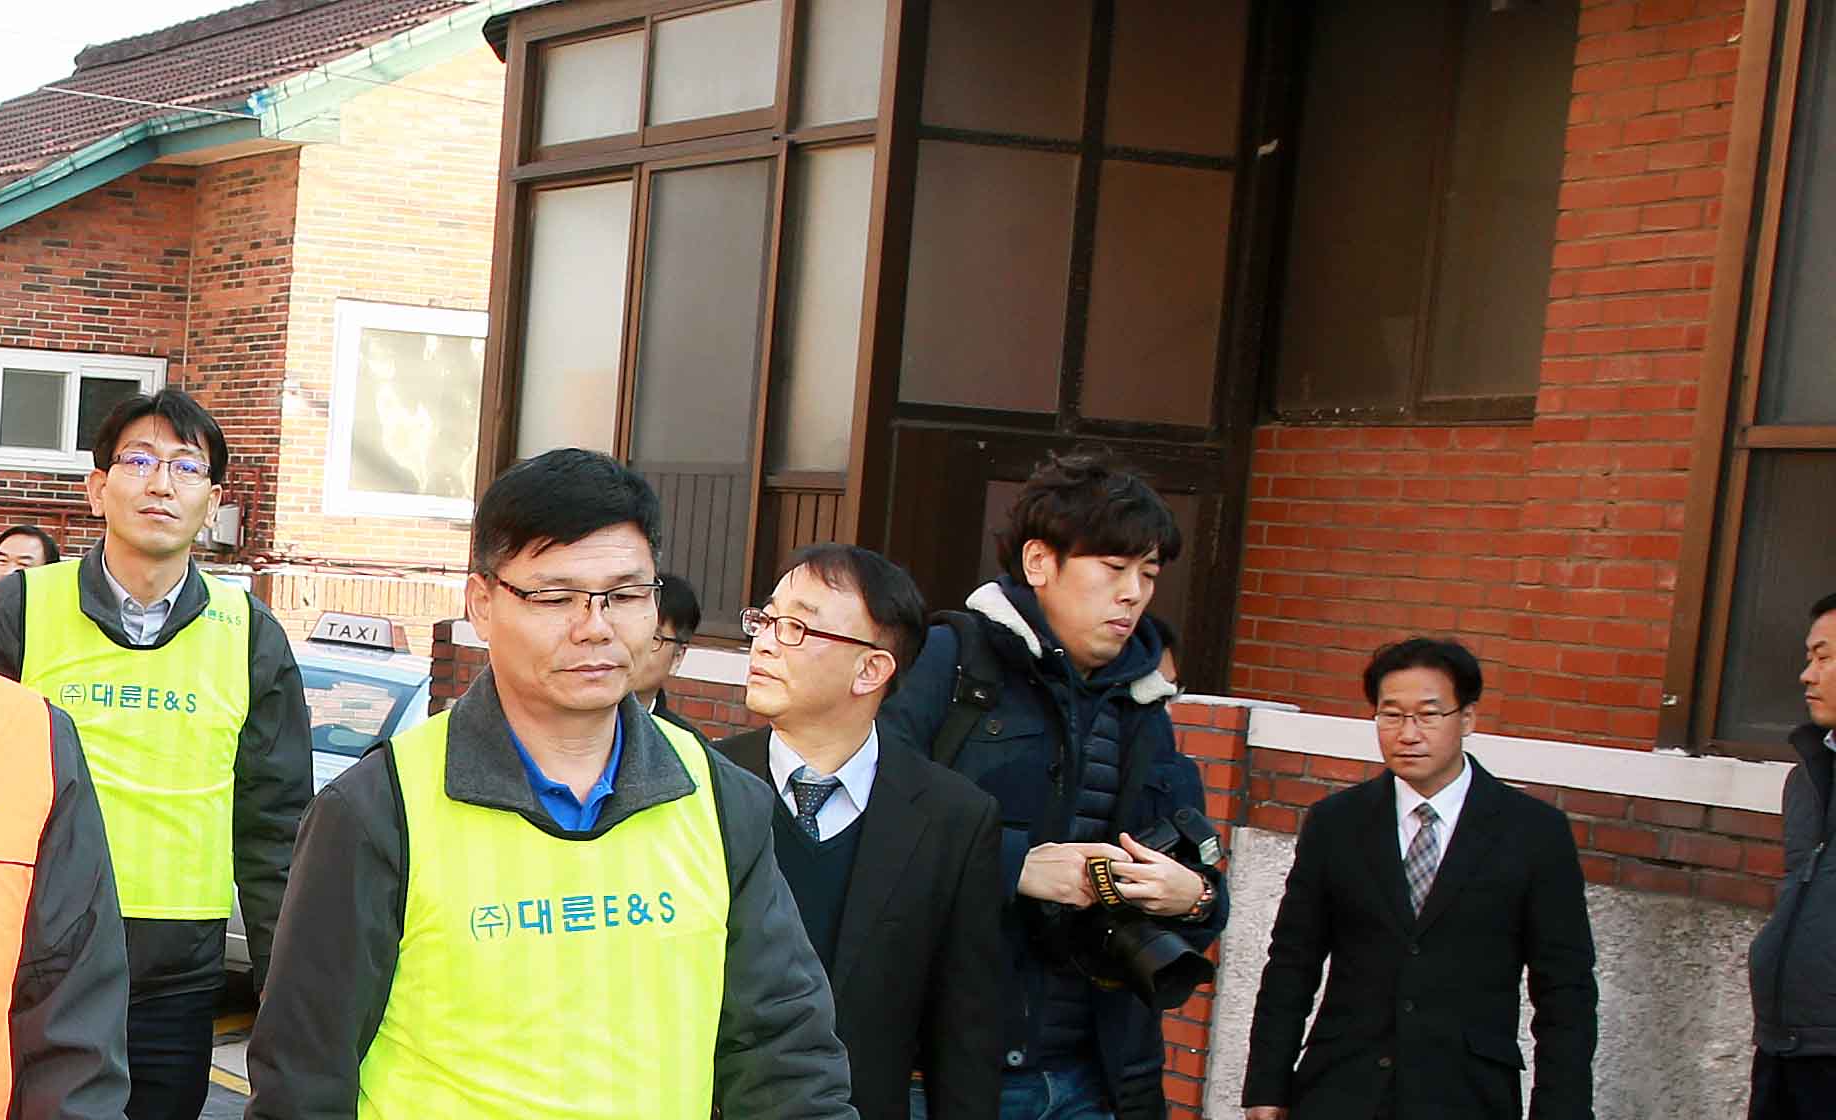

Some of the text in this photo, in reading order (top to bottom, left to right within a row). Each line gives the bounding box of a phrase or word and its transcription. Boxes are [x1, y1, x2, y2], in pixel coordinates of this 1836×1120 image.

[326, 622, 378, 642] TAXI
[59, 683, 197, 714] (주)대륜E&S
[469, 891, 677, 941] (주)대륜E&S
